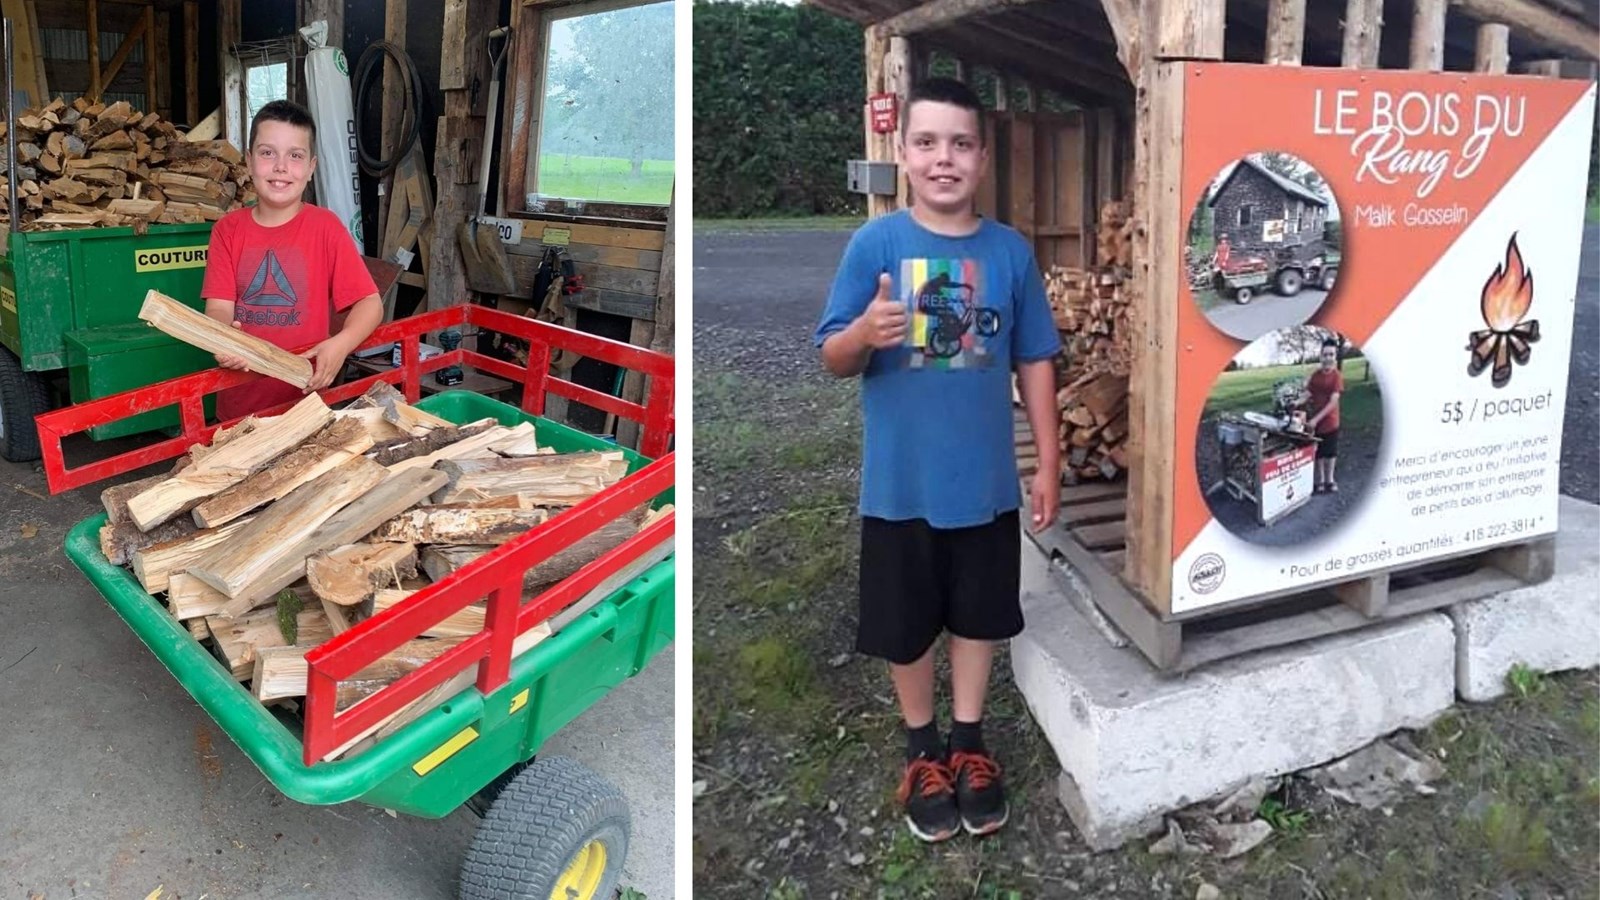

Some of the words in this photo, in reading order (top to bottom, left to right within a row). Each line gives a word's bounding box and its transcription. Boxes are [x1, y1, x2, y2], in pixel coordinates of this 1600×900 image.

[1313, 88, 1358, 135] LE
[1371, 91, 1461, 137] BOIS
[1473, 94, 1527, 138] DU
[1350, 124, 1452, 199] Rang
[1354, 205, 1397, 228] Malik
[1403, 202, 1469, 226] Gosselin
[234, 306, 301, 327] Reebok
[1441, 400, 1464, 426] 5$
[1483, 388, 1553, 422] paquet
[1395, 456, 1427, 469] Merci
[1379, 467, 1455, 489] entrepreneur
[1406, 488, 1423, 502] de
[1411, 503, 1427, 517] de
[1290, 563, 1321, 578] Pour
[1325, 556, 1343, 572] de
[1346, 547, 1393, 571] grosses
